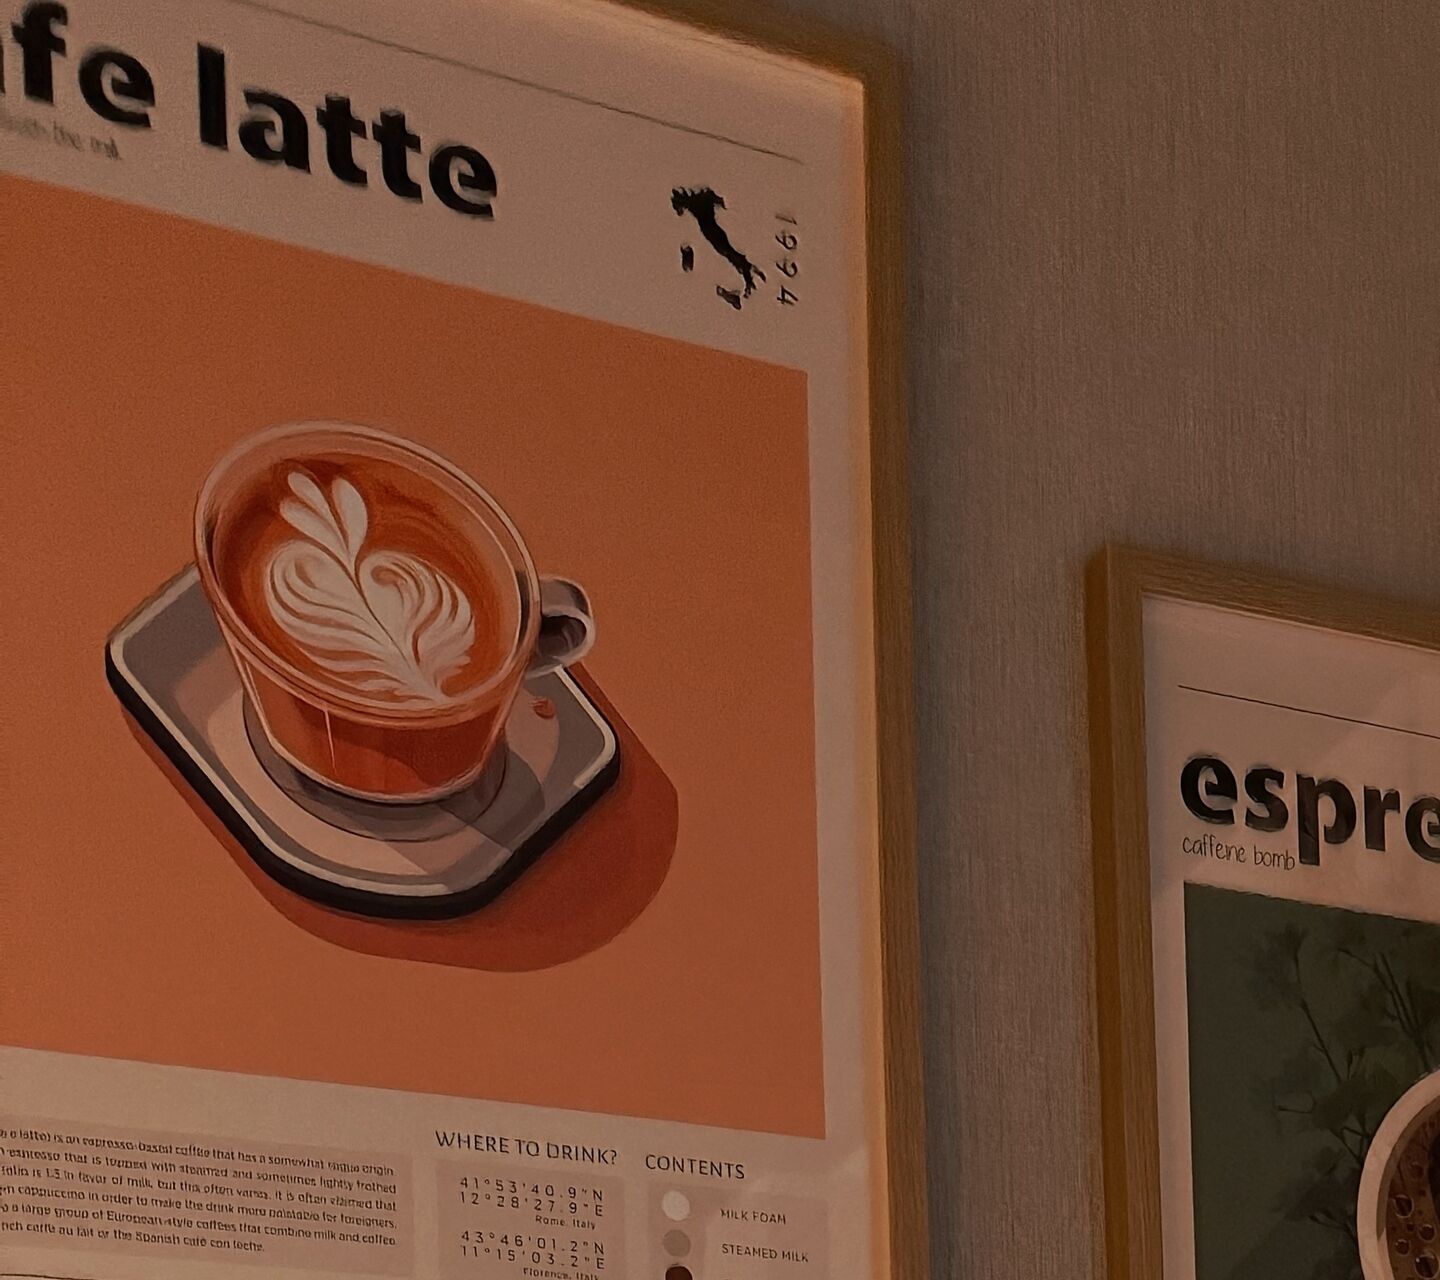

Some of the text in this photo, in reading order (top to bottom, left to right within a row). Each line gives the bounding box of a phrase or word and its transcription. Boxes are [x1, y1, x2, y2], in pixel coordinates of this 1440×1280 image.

[0, 0, 499, 222] fe latte
[1182, 834, 1296, 870] caffeine bomb
[435, 1130, 618, 1166] WHERE TO DRINK?
[645, 1153, 746, 1181] CONTENTS
[720, 1208, 786, 1225] MILK FOAM
[314, 1230, 336, 1240] milk
[722, 1243, 809, 1263] STEAMED MILK
